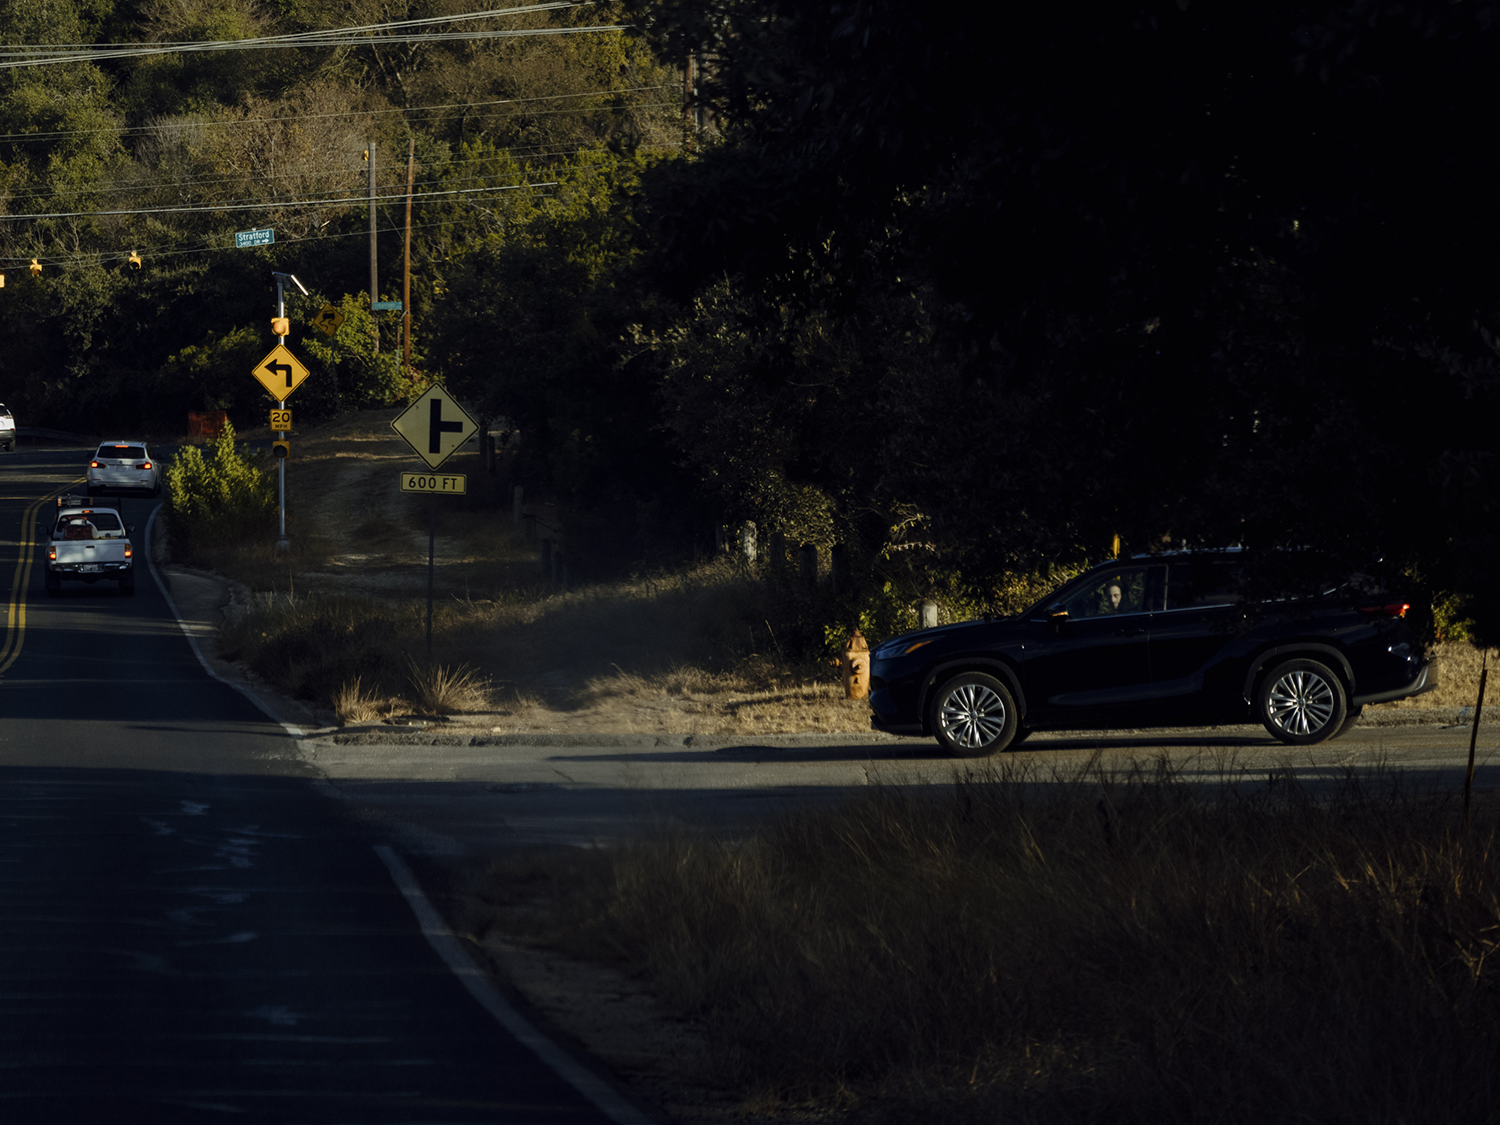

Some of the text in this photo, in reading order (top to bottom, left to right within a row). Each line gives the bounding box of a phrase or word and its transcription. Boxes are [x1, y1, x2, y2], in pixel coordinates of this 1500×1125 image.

[239, 231, 269, 241] Stratford
[273, 412, 289, 423] 20
[409, 476, 457, 489] 600 FT
